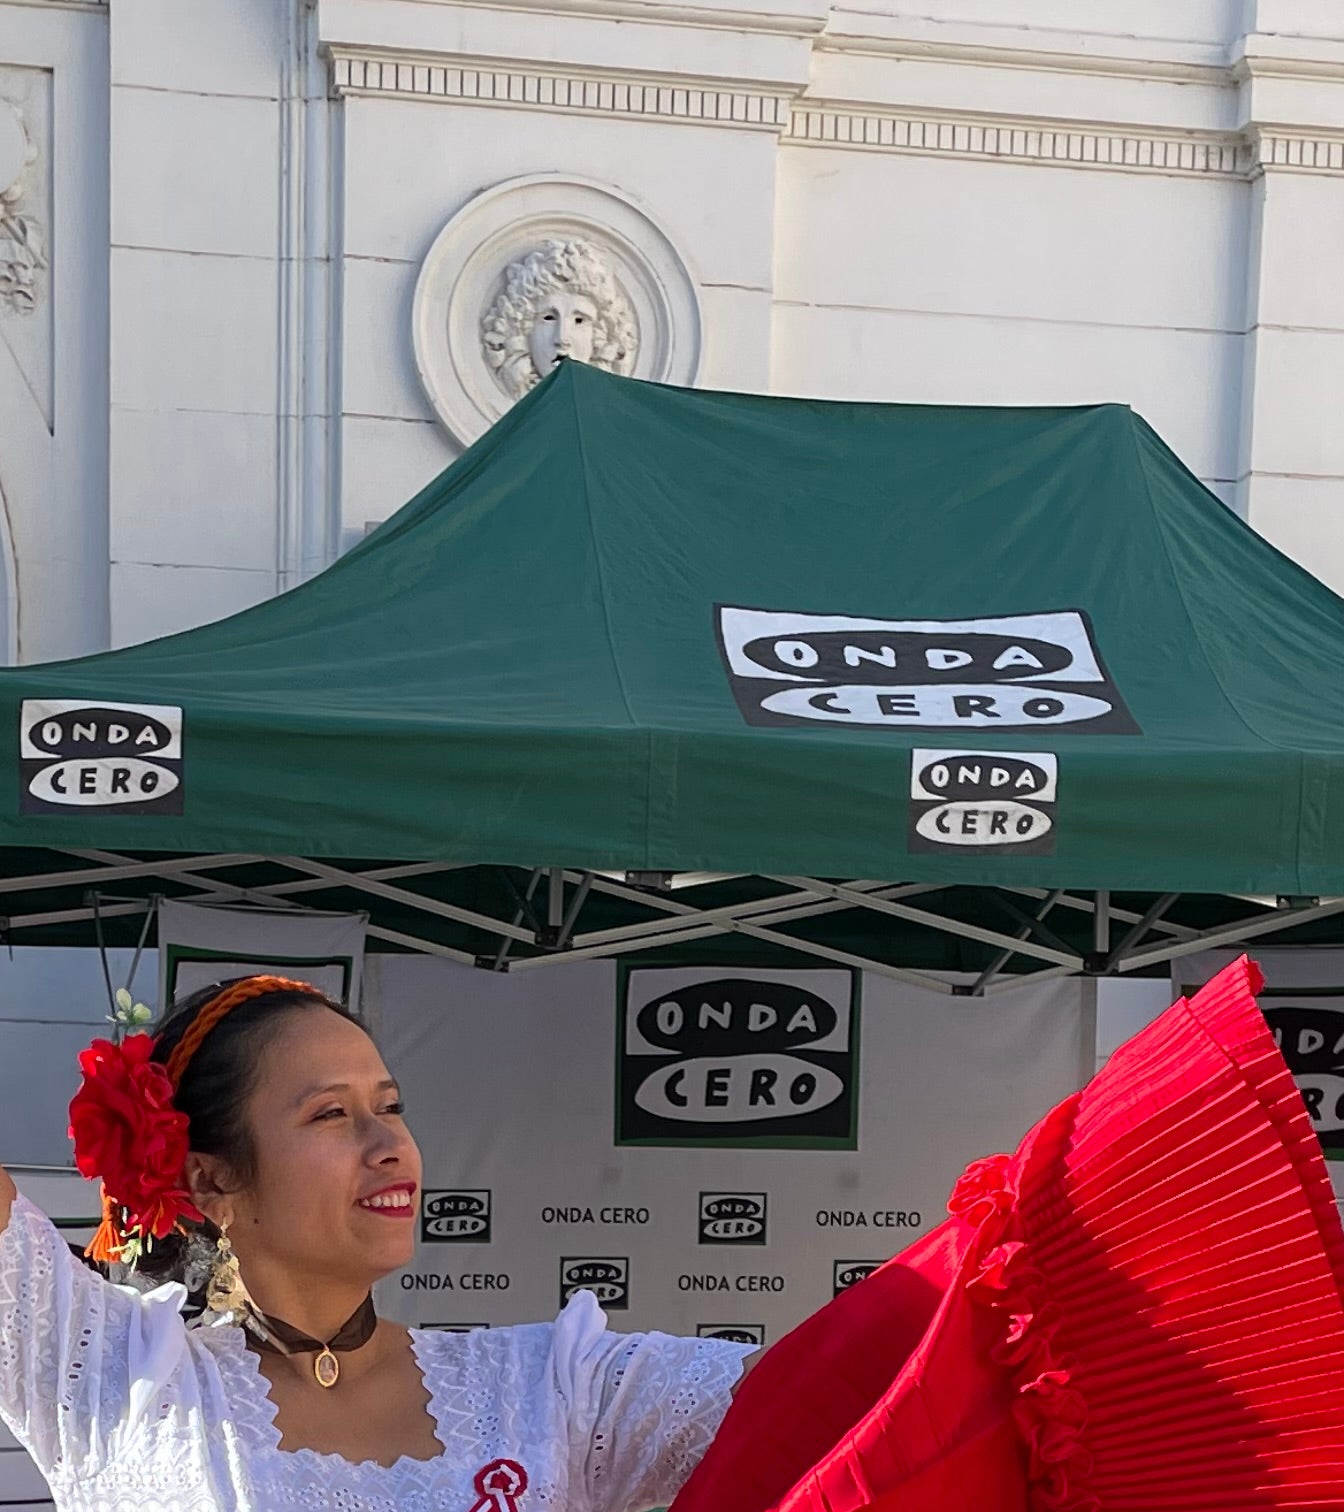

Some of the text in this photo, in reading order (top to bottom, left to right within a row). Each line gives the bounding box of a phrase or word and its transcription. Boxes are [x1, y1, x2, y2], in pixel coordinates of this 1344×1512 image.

[774, 640, 1044, 670] ONDA
[808, 693, 1064, 719] CERO
[42, 721, 159, 746] ONDA
[50, 766, 159, 795] CERO
[930, 764, 1036, 788] ONDA
[935, 809, 1033, 835] CERO
[657, 1001, 817, 1035] ONDA
[664, 1068, 816, 1107] CERO
[432, 1201, 479, 1212] ONDA
[709, 1204, 755, 1214] ONDA
[542, 1207, 649, 1223] ONDA CERO
[816, 1210, 921, 1227] ONDA CERO
[434, 1220, 479, 1231] CERO
[712, 1222, 755, 1233] CERO
[401, 1274, 510, 1290] ONDA CERO
[571, 1269, 617, 1279] ONDA
[844, 1271, 866, 1281] ON
[678, 1275, 784, 1291] ONDA CERO
